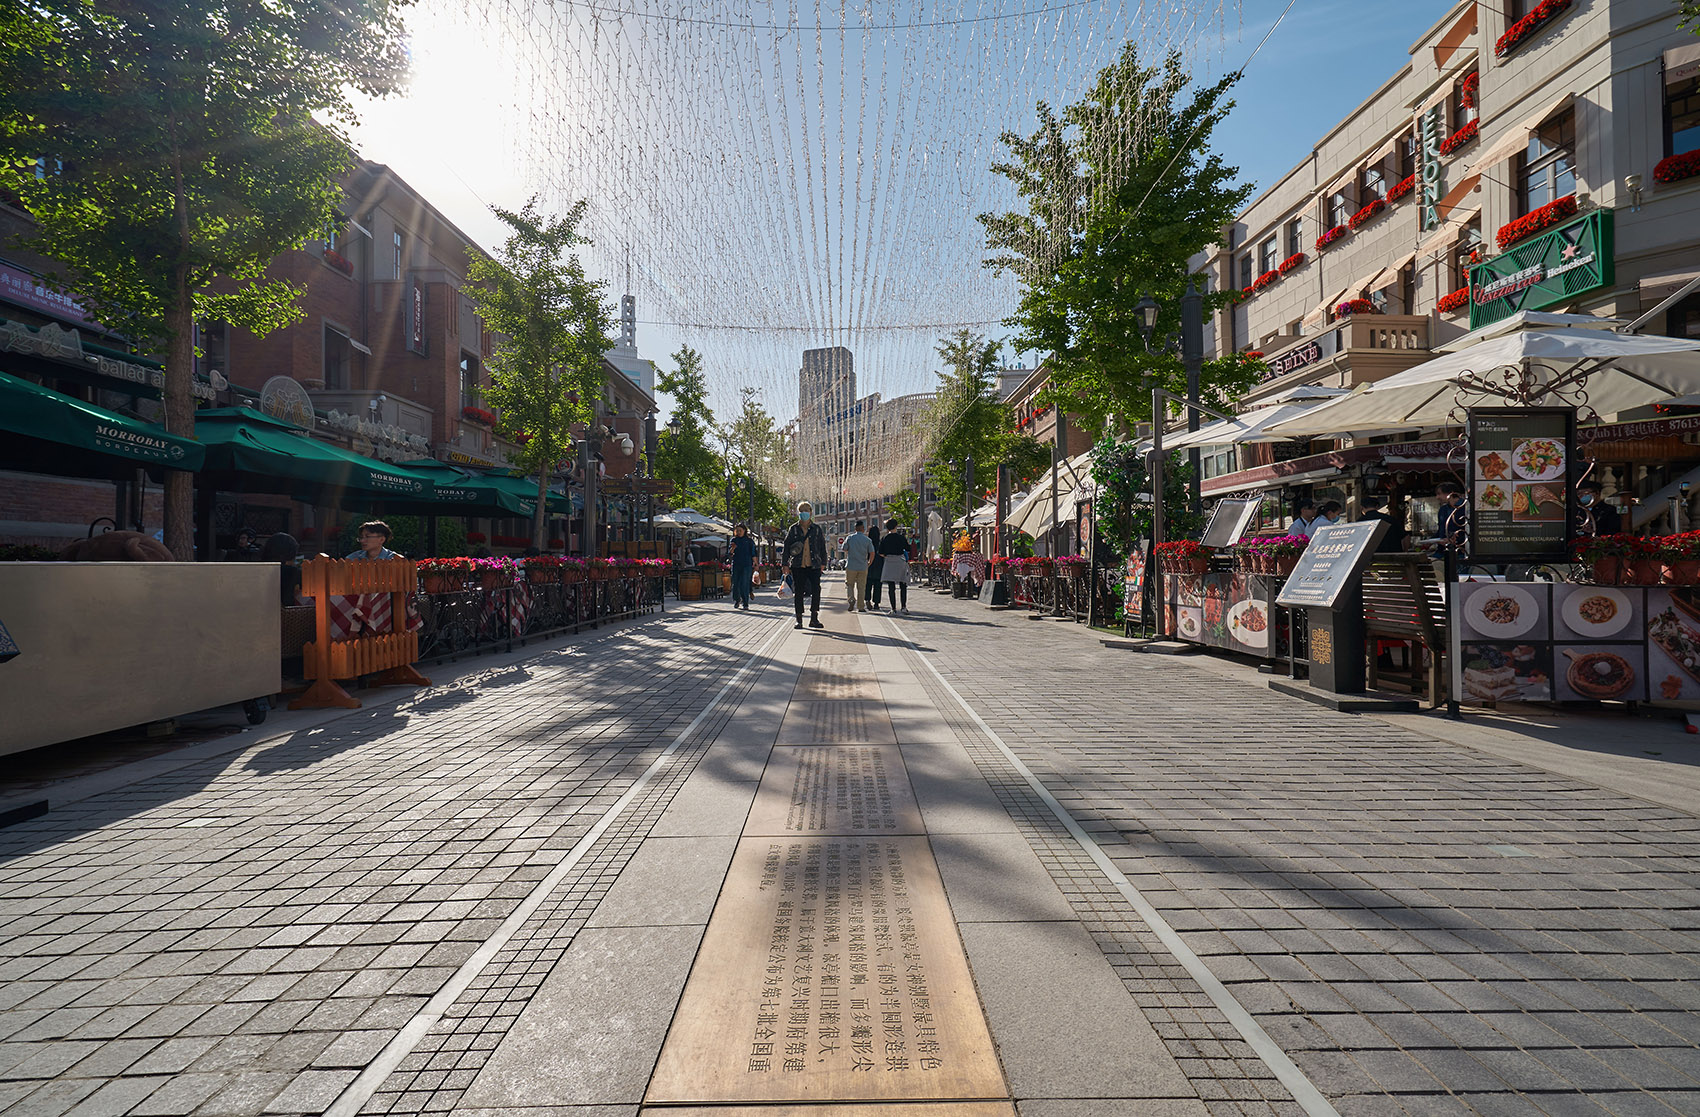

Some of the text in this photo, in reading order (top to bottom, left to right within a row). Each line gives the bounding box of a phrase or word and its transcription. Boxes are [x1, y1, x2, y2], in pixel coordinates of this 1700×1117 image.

[1547, 256, 1593, 278] Heineken
[1518, 272, 1542, 289] CLUB
[100, 356, 145, 384] ballad
[1276, 345, 1318, 376] SEINE
[96, 425, 168, 448] MORROBAY
[96, 440, 168, 458] BORDEAUX
[370, 472, 412, 485] MORROBAY
